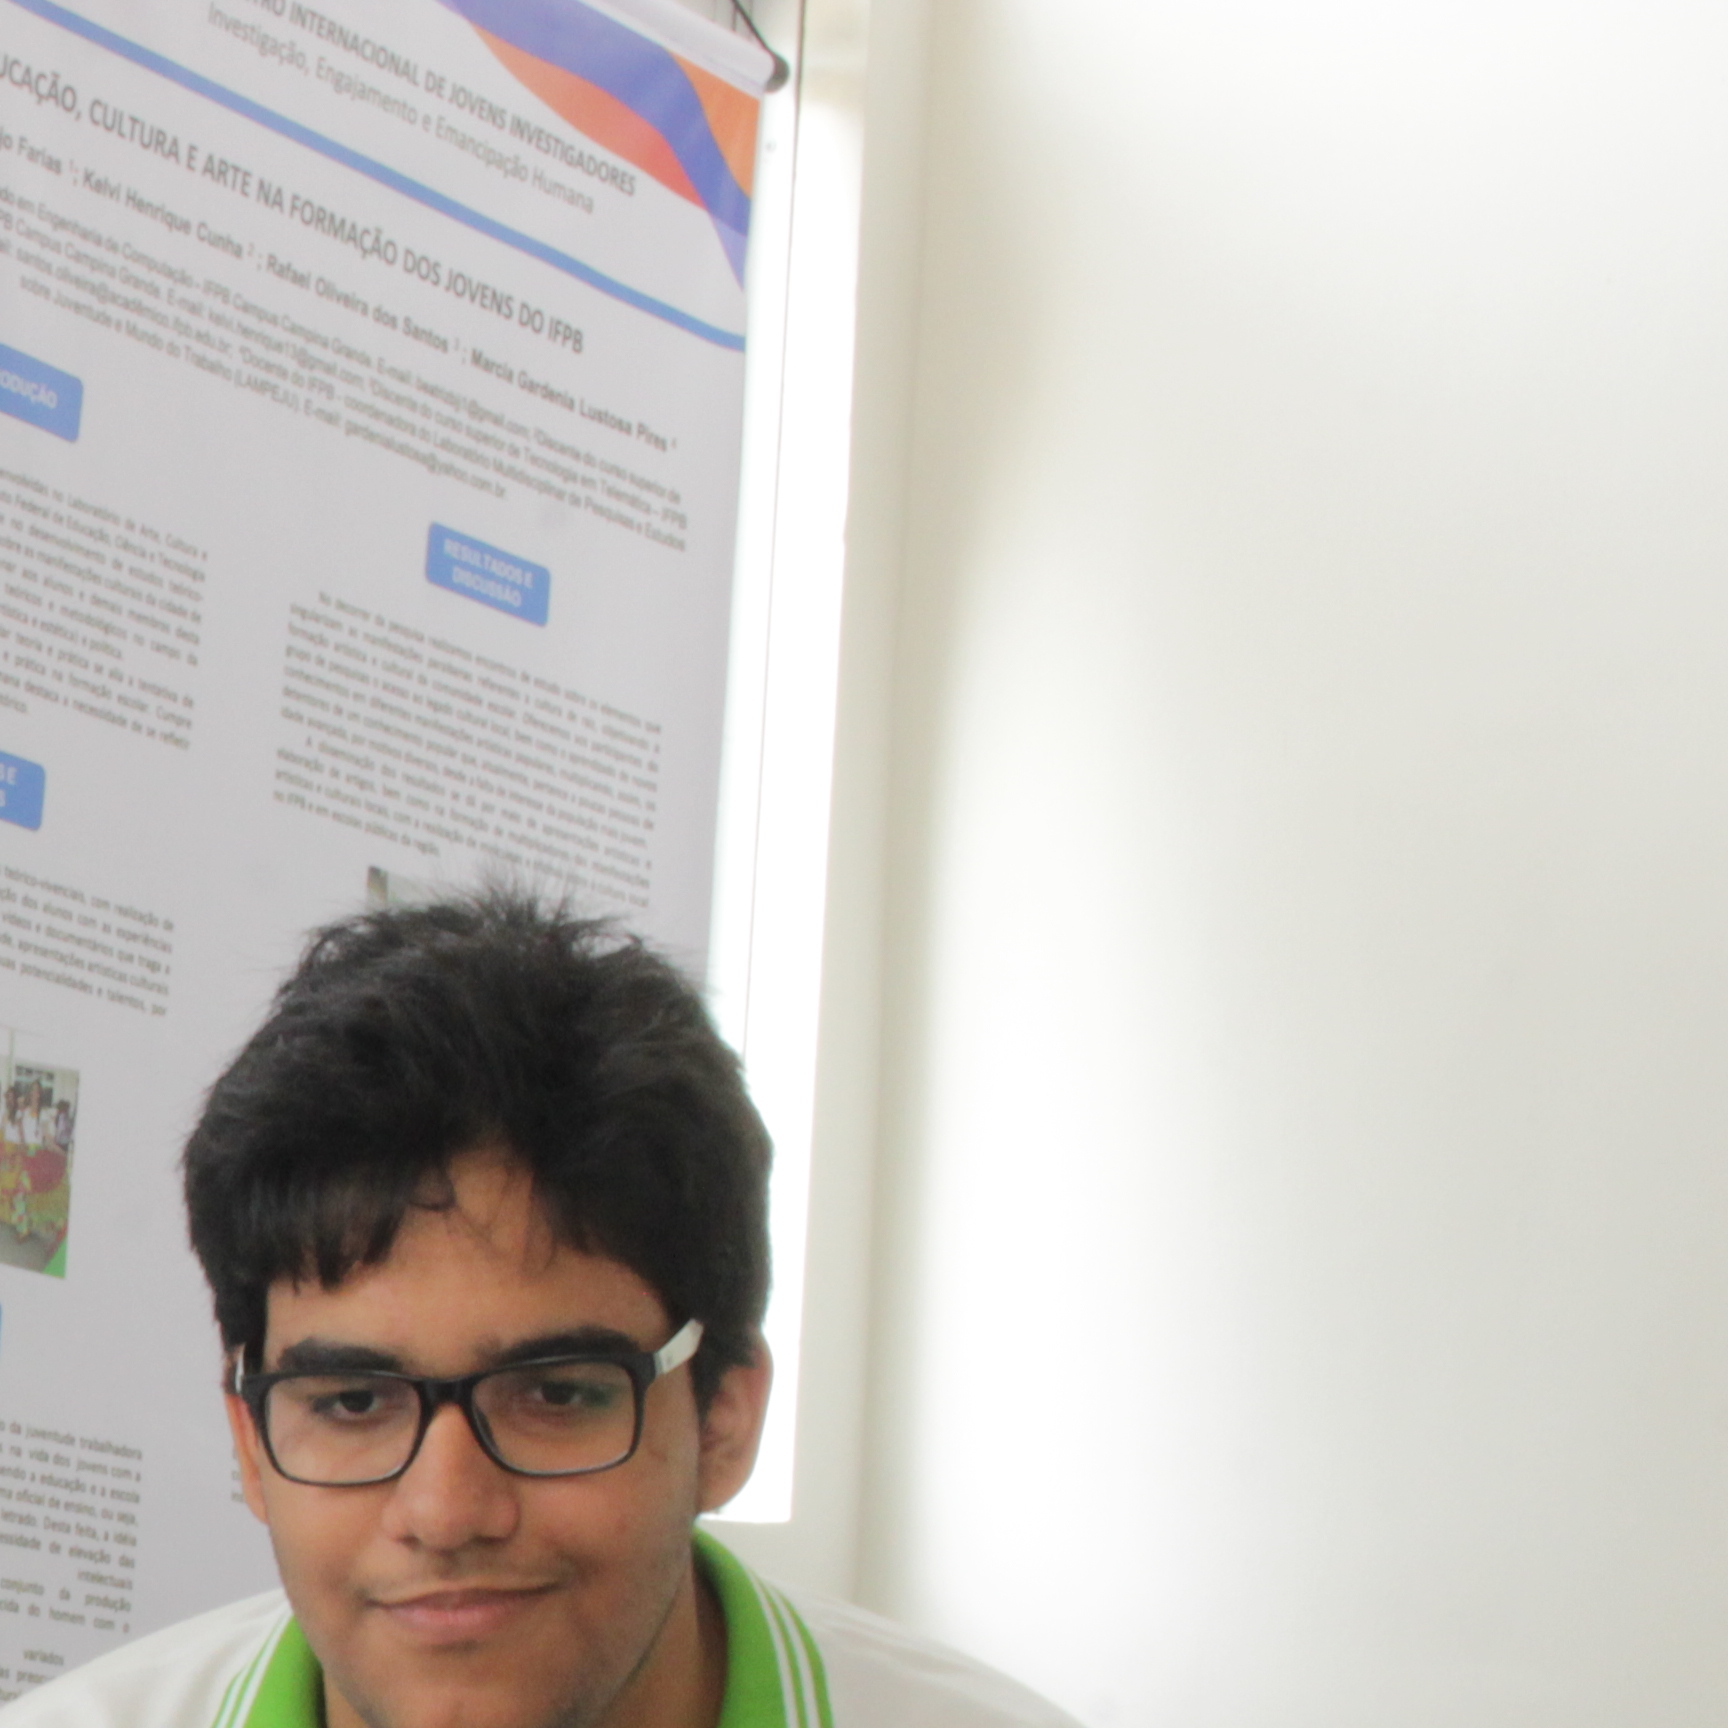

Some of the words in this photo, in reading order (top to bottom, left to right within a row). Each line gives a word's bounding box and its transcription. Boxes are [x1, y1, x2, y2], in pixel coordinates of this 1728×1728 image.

[208, 3, 309, 74] Investigação,
[316, 57, 418, 124] Engajamento
[435, 116, 529, 181] Emancipação
[532, 168, 594, 214] Humana
[289, 3, 419, 85] INTERNACIONAL
[424, 70, 447, 99] DE
[448, 84, 507, 130] JOVENS
[509, 116, 636, 195] INVESTIGADORES
[18, 136, 62, 175] Farias
[83, 169, 121, 201] Kelvi
[125, 189, 192, 234] Henrique
[196, 222, 243, 259] Cunha
[266, 254, 311, 289] Rafael
[314, 277, 369, 316] Oliveira
[372, 306, 398, 330] dos
[402, 317, 449, 353] Santos
[470, 349, 514, 383] Marcia
[518, 371, 575, 411] Gardenia
[579, 400, 633, 436] Lustosa
[636, 422, 667, 452] Pires
[89, 99, 180, 163] CULTURA
[186, 144, 198, 172] E
[202, 154, 252, 197] ARTE
[256, 179, 284, 212] NA
[289, 195, 398, 265] FORMAÇÃO
[403, 248, 441, 286] DOS
[444, 270, 514, 320] JOVENS
[518, 302, 545, 334] DO
[548, 318, 583, 354] IFPB
[444, 538, 523, 585] RESULTADOS
[524, 570, 533, 589] E
[452, 566, 521, 607] DISCUSSÃO
[7, 766, 17, 785] E
